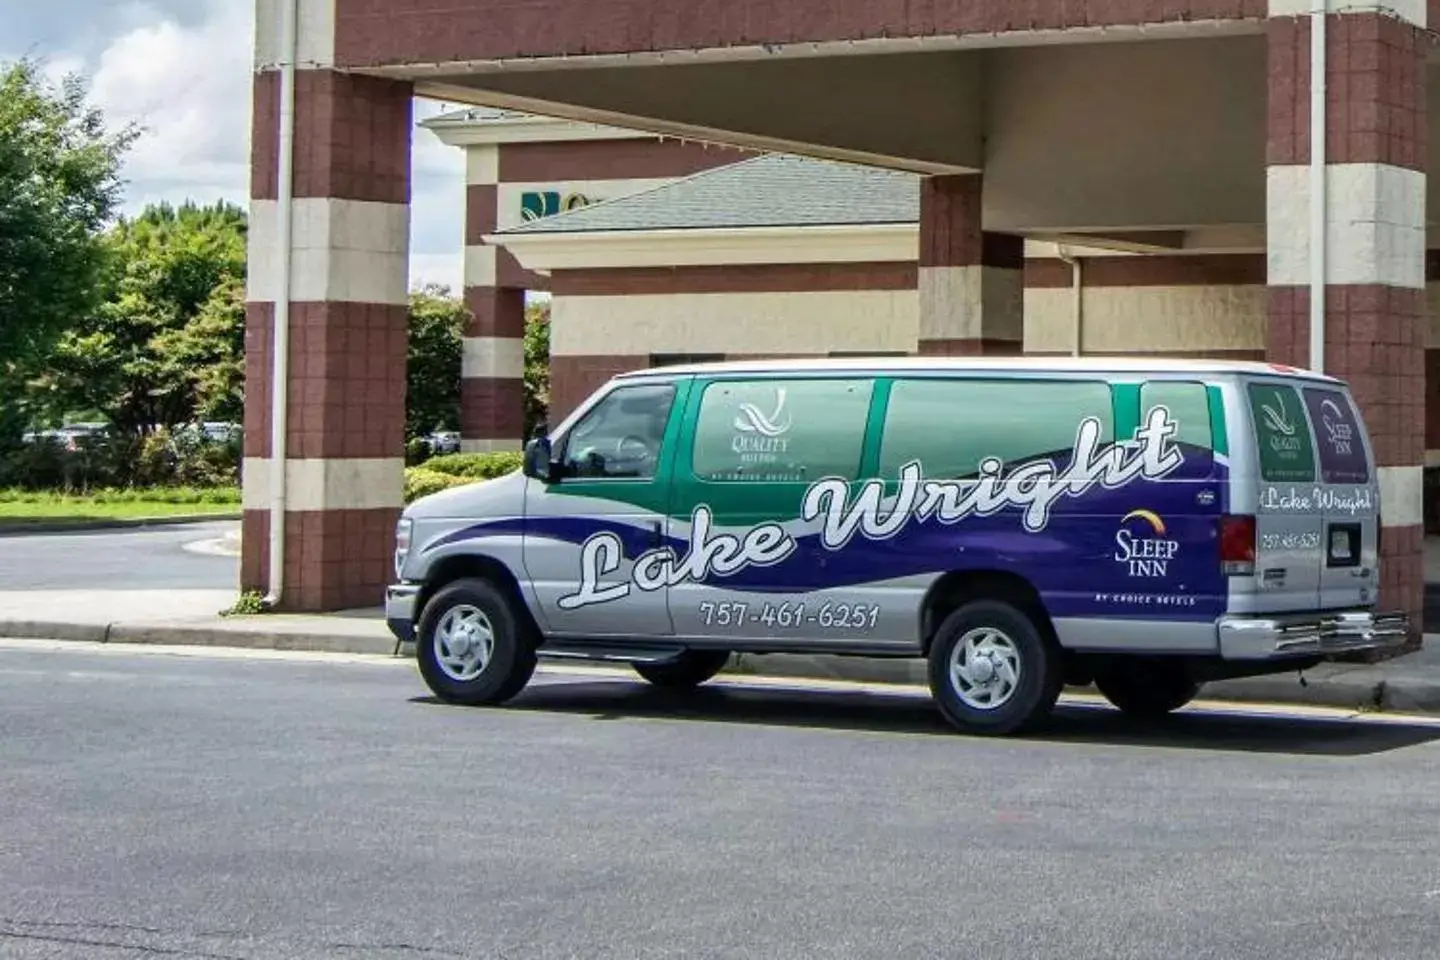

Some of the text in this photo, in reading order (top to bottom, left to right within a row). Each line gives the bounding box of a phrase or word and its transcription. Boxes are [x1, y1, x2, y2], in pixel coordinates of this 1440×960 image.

[558, 405, 1184, 610] Lake Wright
[1264, 487, 1371, 515] Lake Wright
[1115, 529, 1179, 561] SLEEP
[1128, 560, 1168, 577] INN
[1113, 594, 1150, 603] CHOICE
[1156, 596, 1196, 605] HOTELS
[700, 602, 879, 627] 757-461-6251
